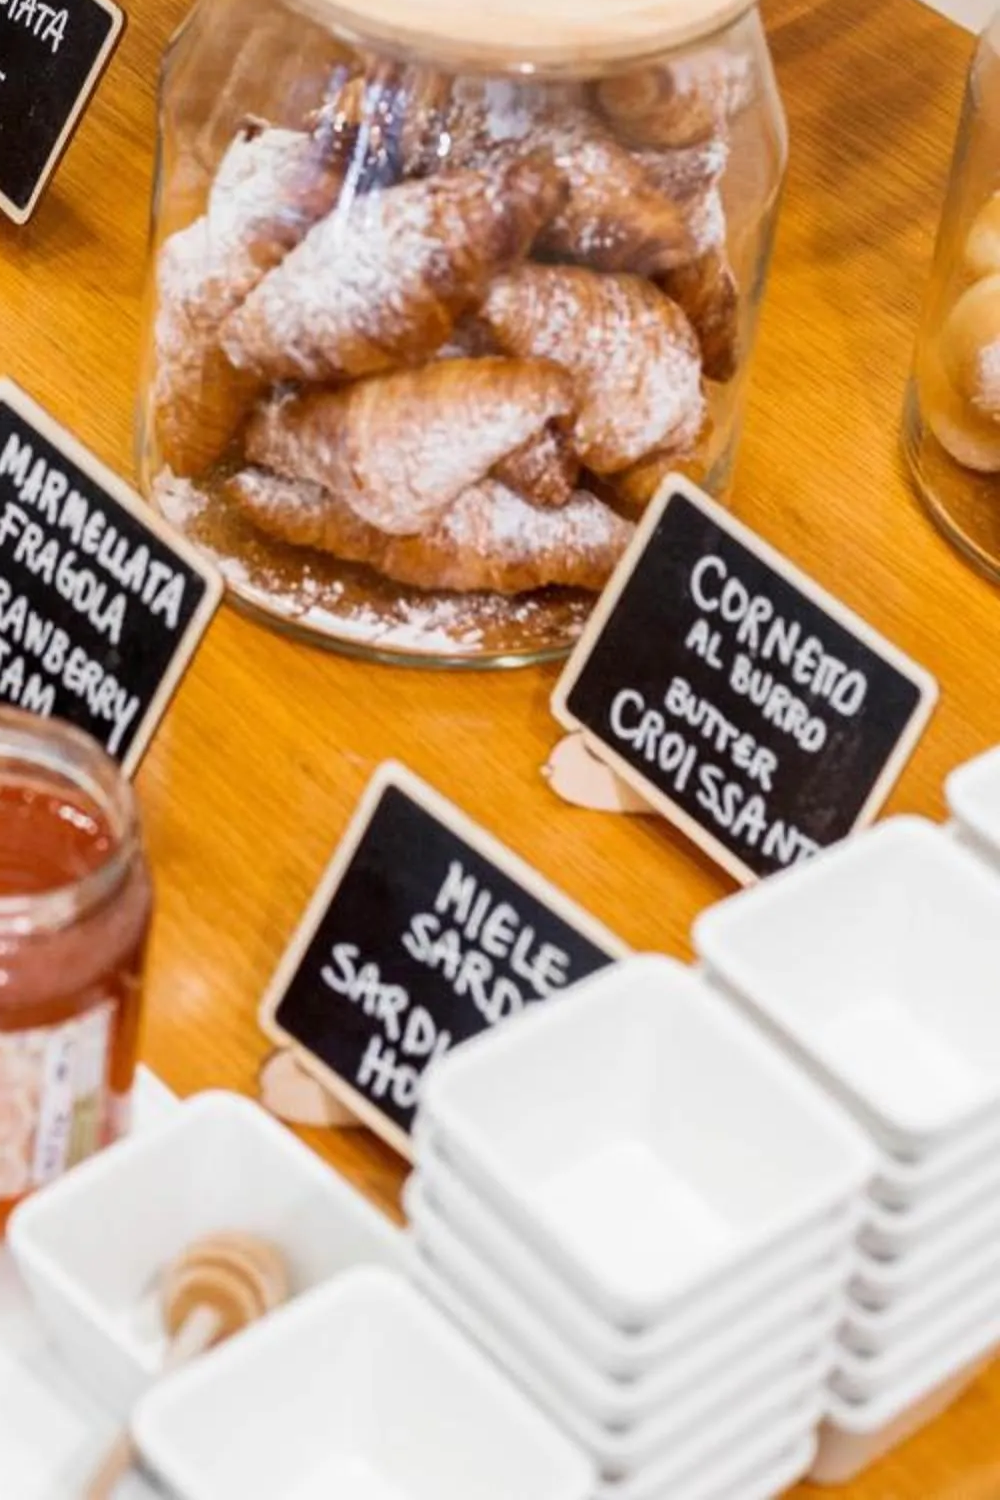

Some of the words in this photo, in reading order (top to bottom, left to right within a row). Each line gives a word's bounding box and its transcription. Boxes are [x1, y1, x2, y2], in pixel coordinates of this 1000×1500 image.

[685, 617, 724, 670] AL
[729, 655, 827, 753] BURRO
[689, 554, 868, 717] CORNETTO
[664, 676, 778, 793] BUTTER
[401, 912, 524, 1026] SARD
[434, 860, 571, 997] MIELE
